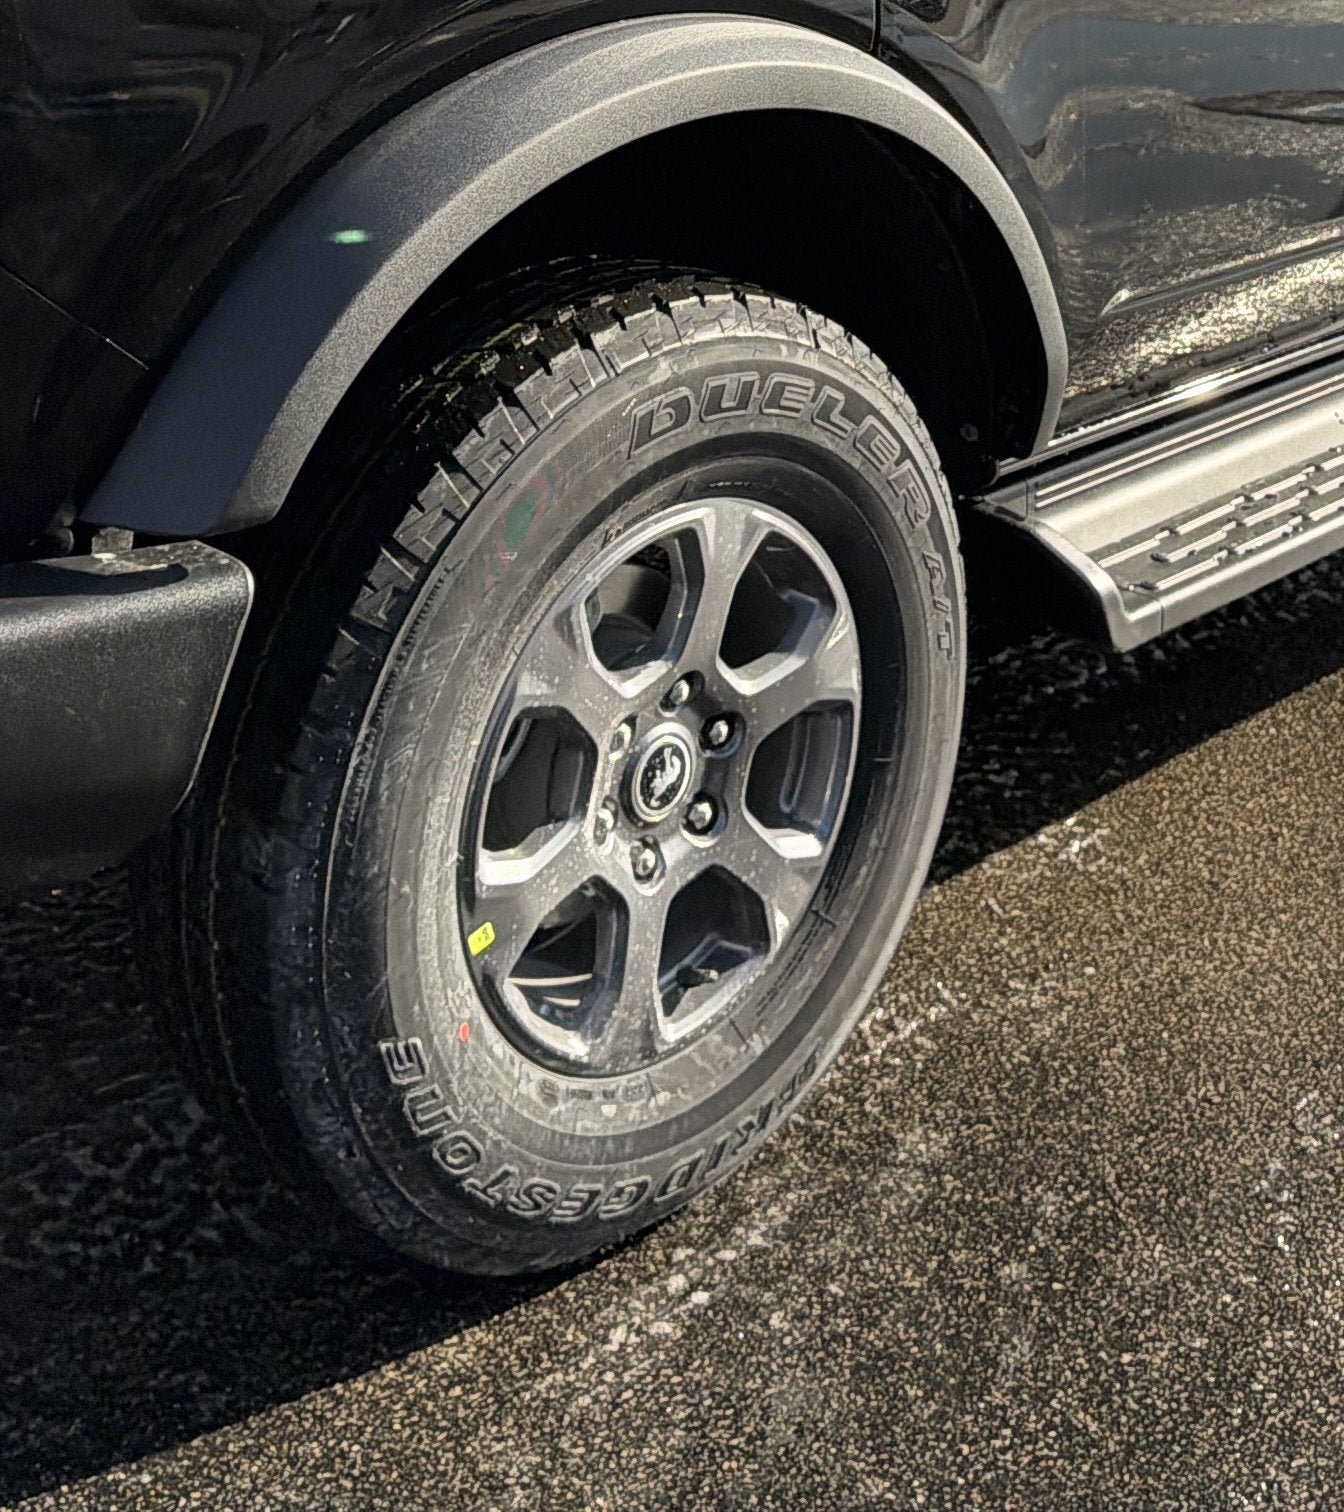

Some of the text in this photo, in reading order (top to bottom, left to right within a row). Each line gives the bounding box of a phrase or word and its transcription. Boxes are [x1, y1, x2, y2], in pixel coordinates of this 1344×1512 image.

[628, 370, 954, 660] DUELER A/T
[377, 1036, 824, 1224] BRIDGESTONE
